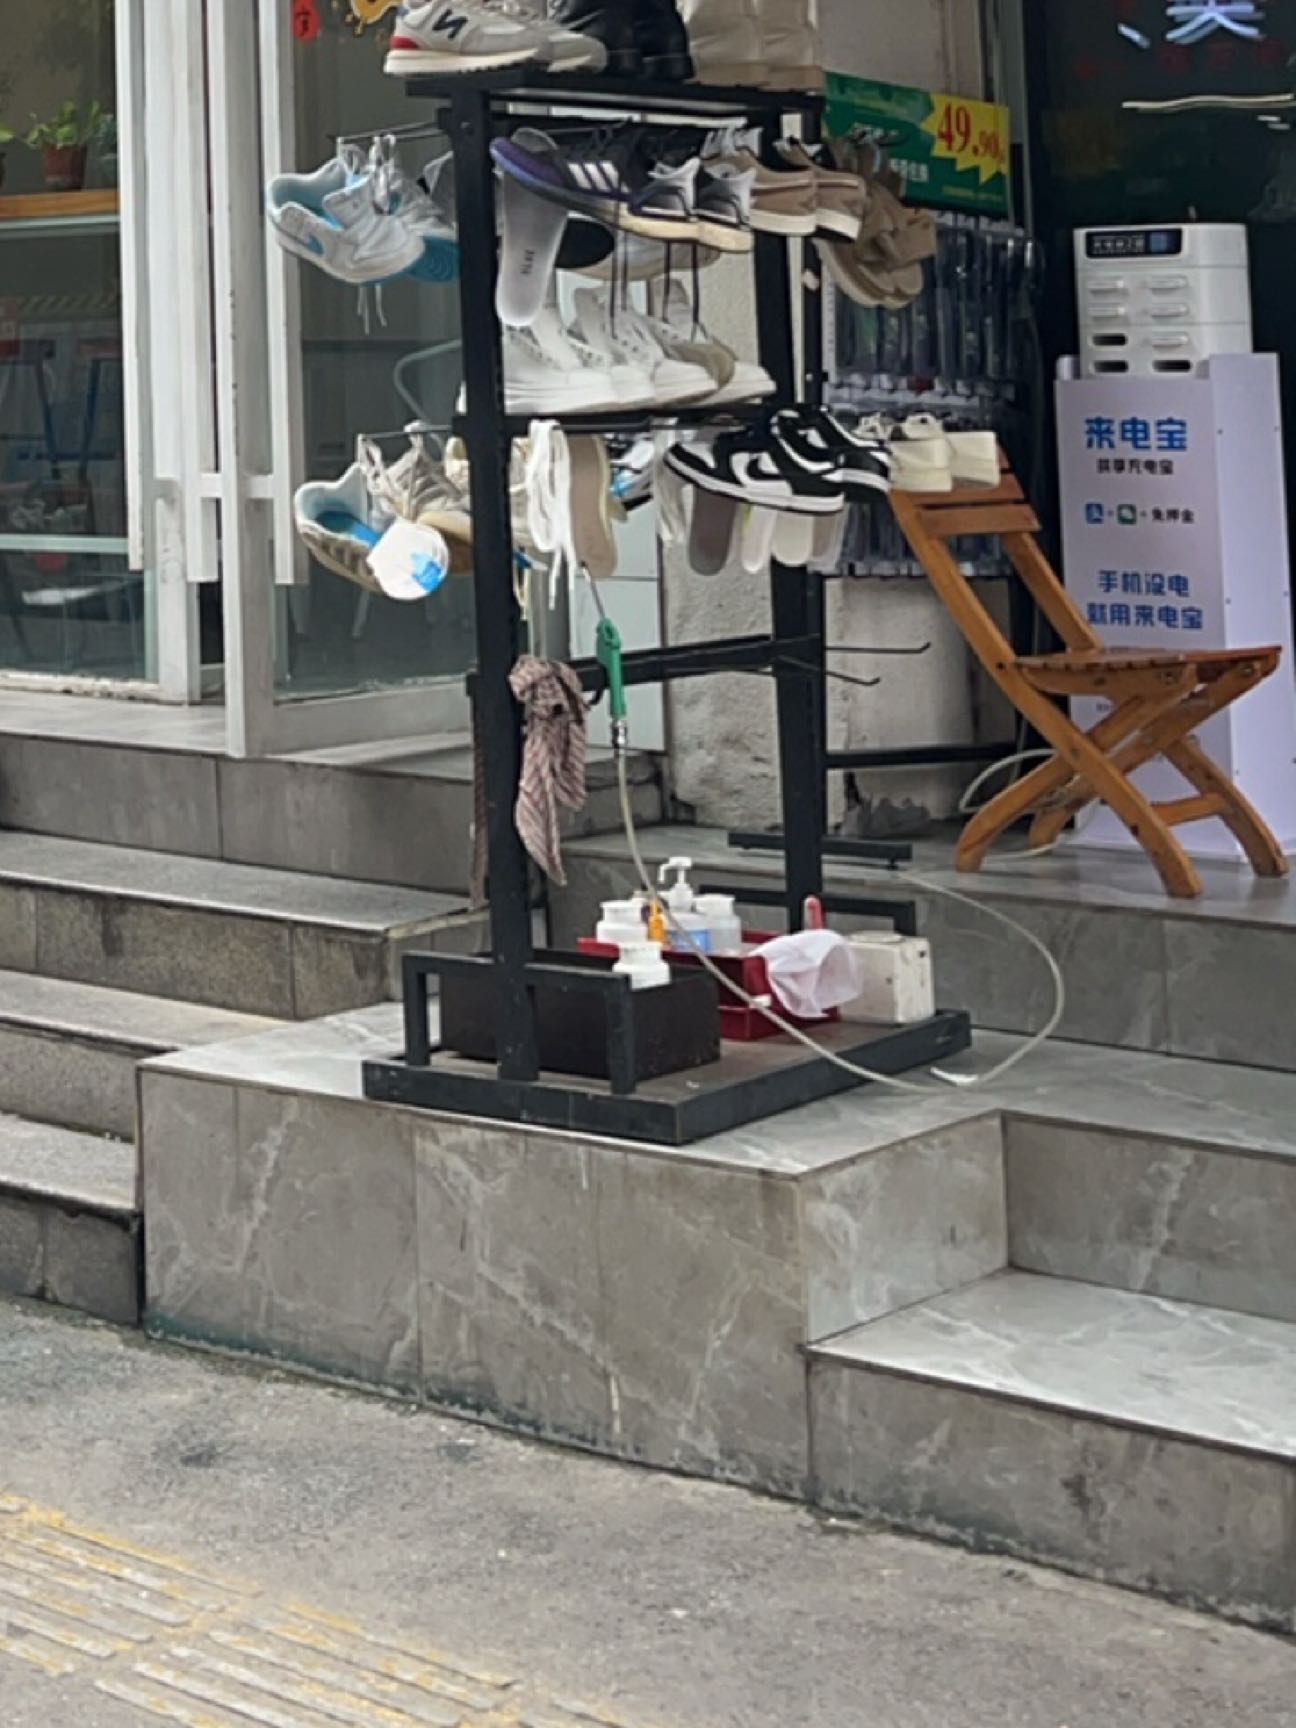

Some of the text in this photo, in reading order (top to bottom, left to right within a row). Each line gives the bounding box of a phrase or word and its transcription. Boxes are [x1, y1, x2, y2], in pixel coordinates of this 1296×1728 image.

[1084, 416, 1188, 452] 来电宝
[1096, 458, 1174, 475] 共享充电宝
[1098, 570, 1190, 597] 手机没电
[1086, 603, 1204, 630] 就用来电宝
